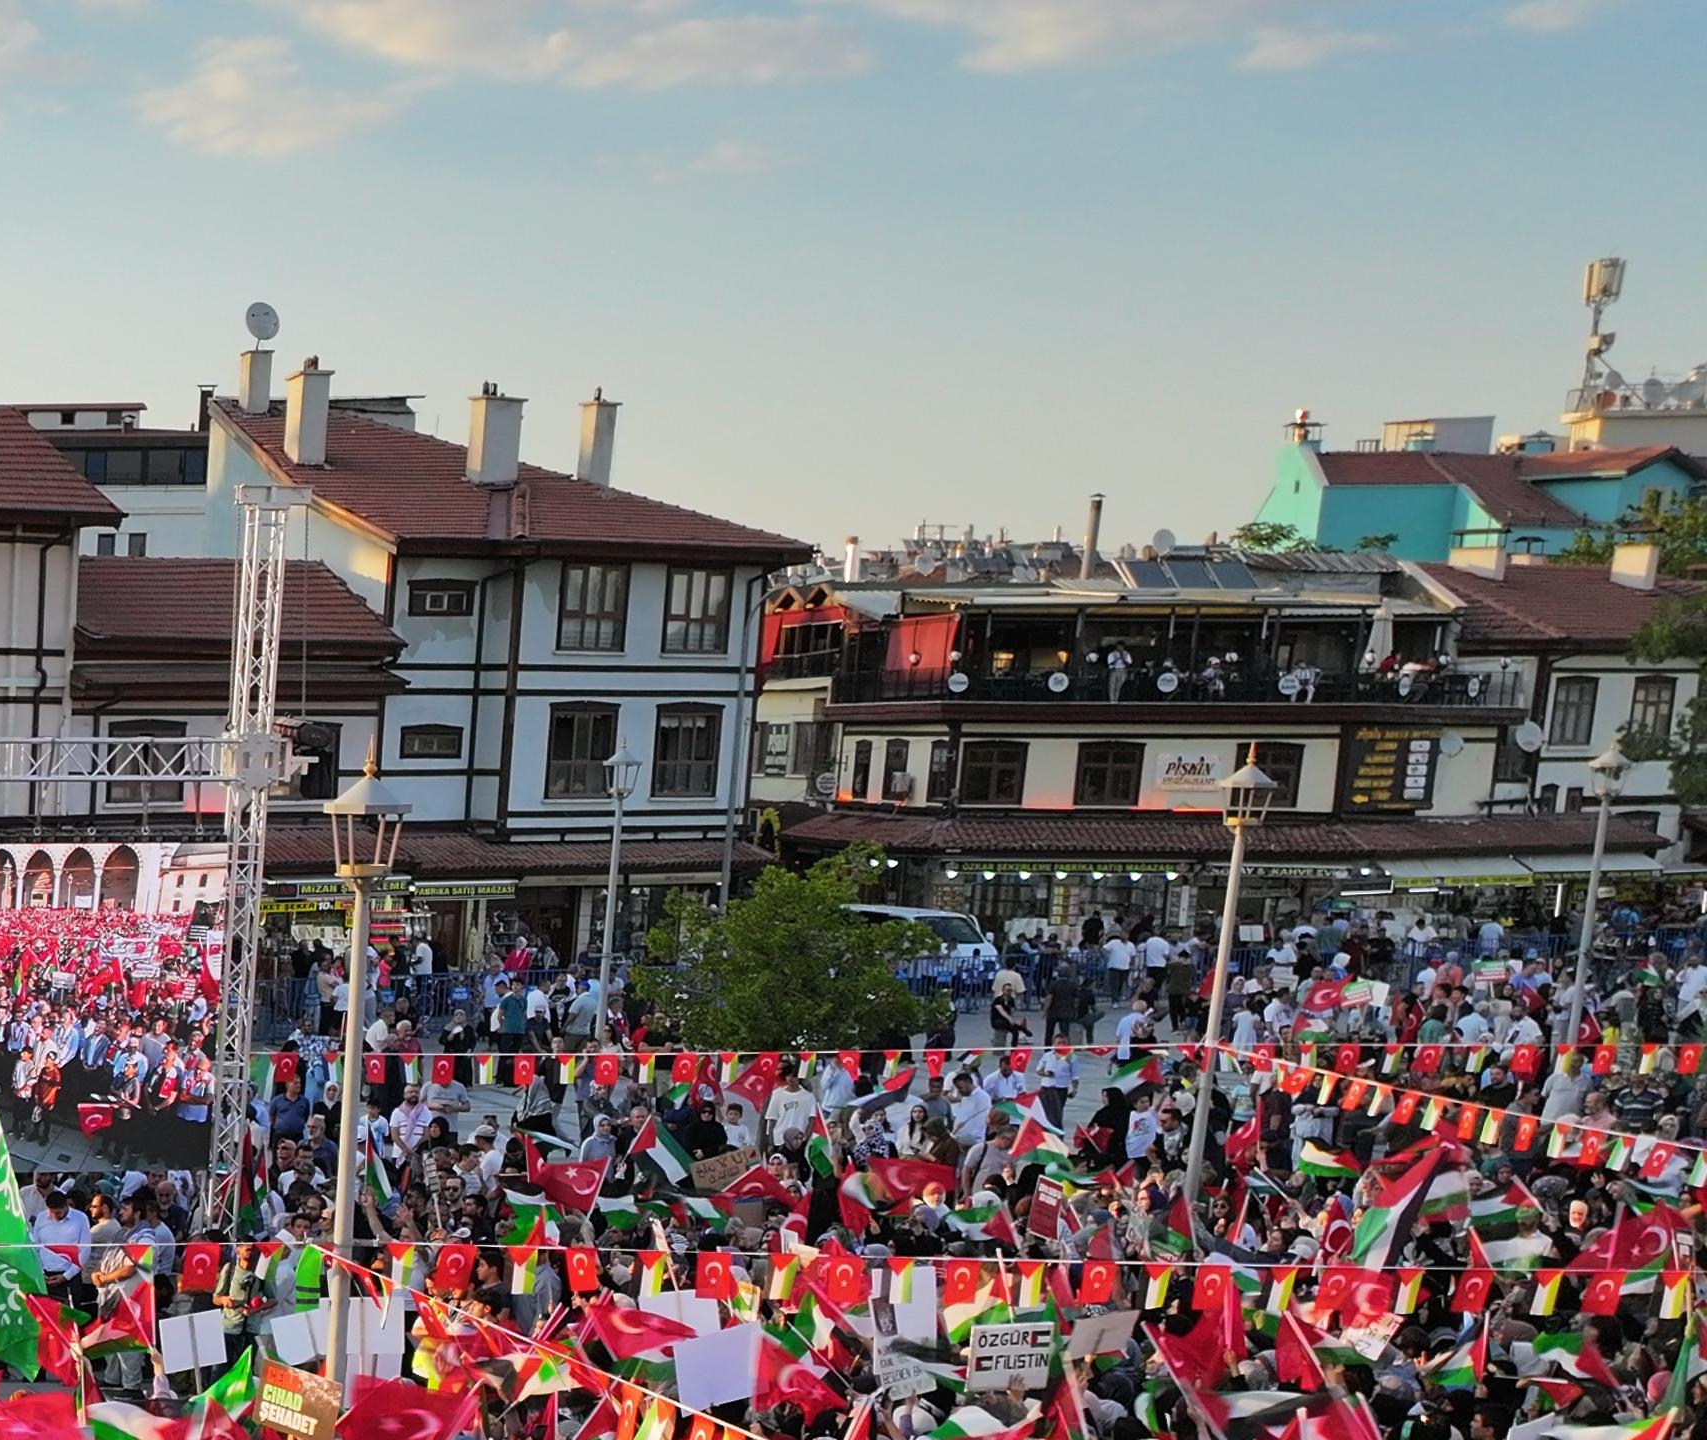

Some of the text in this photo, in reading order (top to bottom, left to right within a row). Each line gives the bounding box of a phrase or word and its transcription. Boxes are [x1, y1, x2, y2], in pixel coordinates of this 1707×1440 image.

[301, 883, 337, 894] MİZAN
[977, 1329, 1031, 1349] ÖZGÜR
[994, 1351, 1049, 1371] FİLİSTİN
[262, 1383, 303, 1412] CİHAD
[259, 1401, 318, 1436] ŞEHADET
